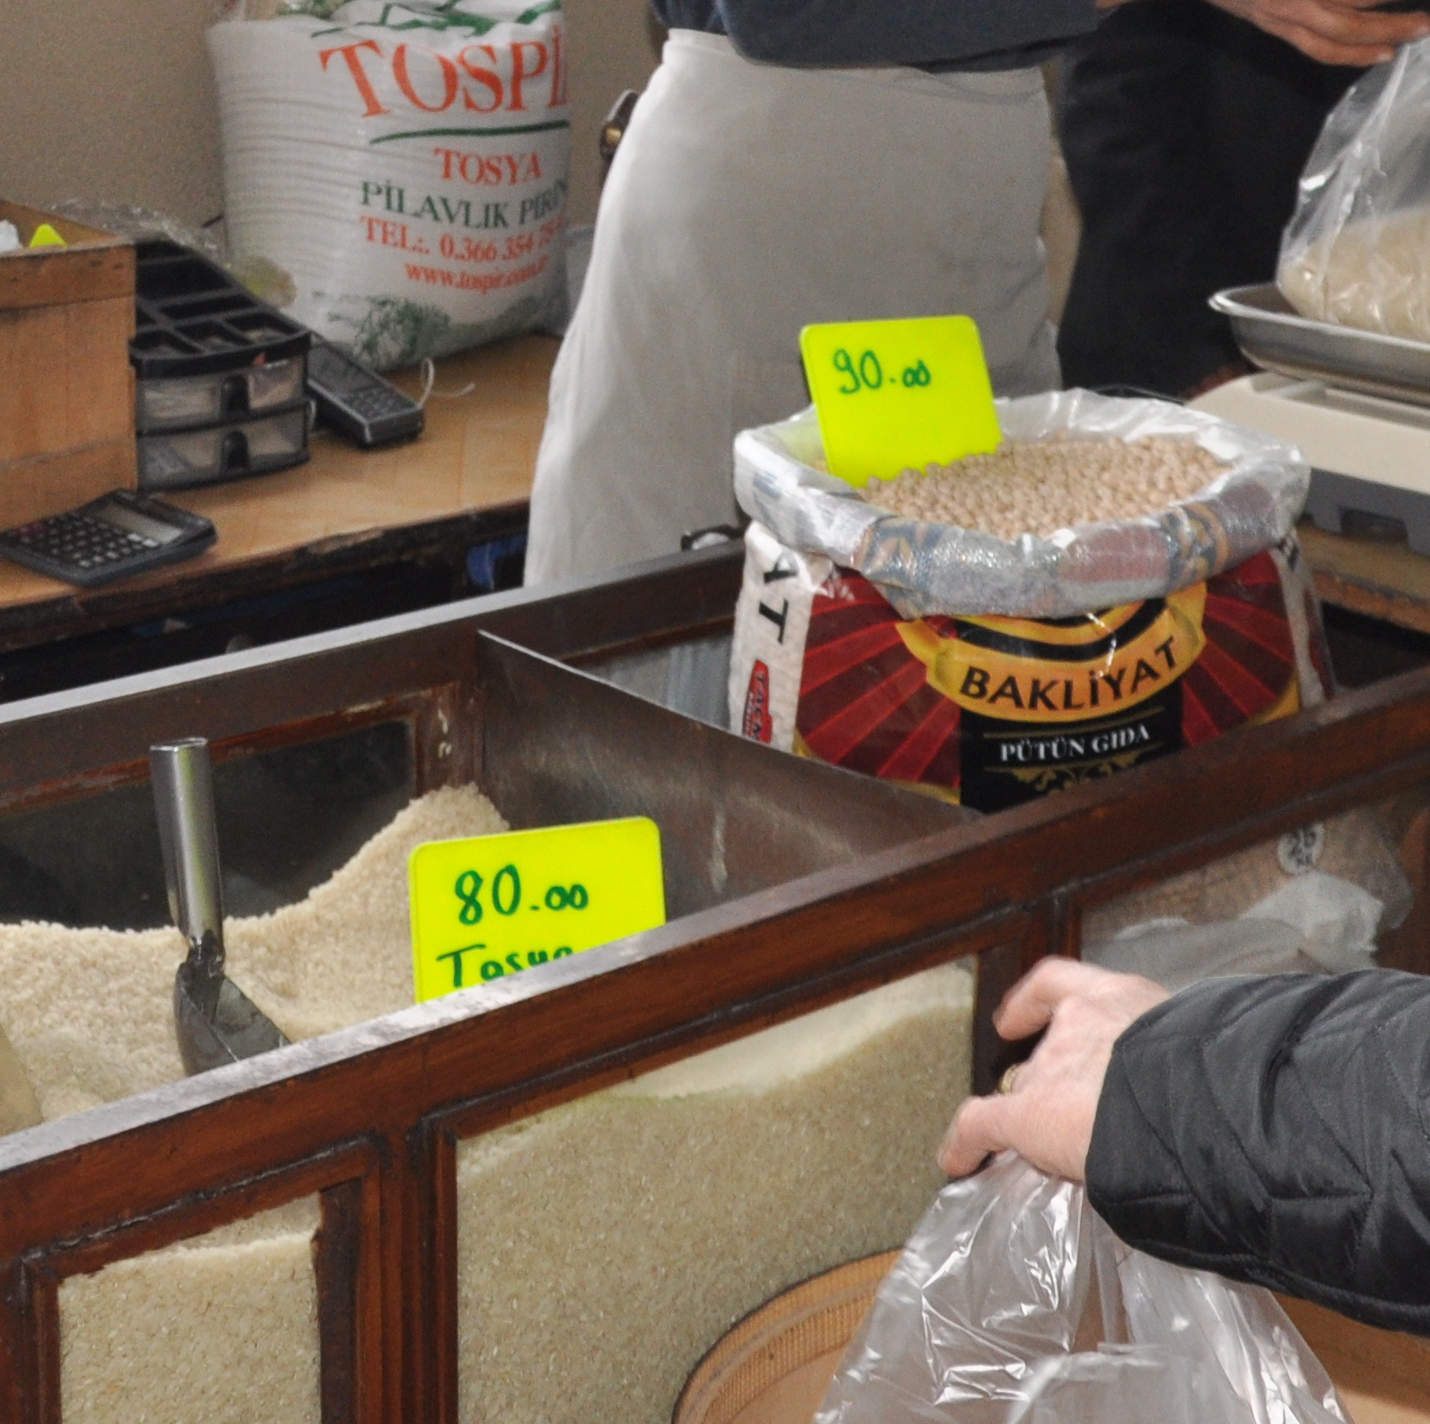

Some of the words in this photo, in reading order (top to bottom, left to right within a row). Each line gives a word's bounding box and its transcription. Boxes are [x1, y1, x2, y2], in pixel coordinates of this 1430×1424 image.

[318, 25, 569, 118] TOSPİ
[433, 147, 542, 188] TOSYA
[361, 179, 510, 231] PİLAVLIK
[832, 347, 932, 395] 90.00
[960, 636, 1177, 711] BAKLİYAT
[999, 734, 1085, 763] PÜTÜN
[1091, 723, 1151, 754] GIDA
[454, 863, 590, 926] 80.00
